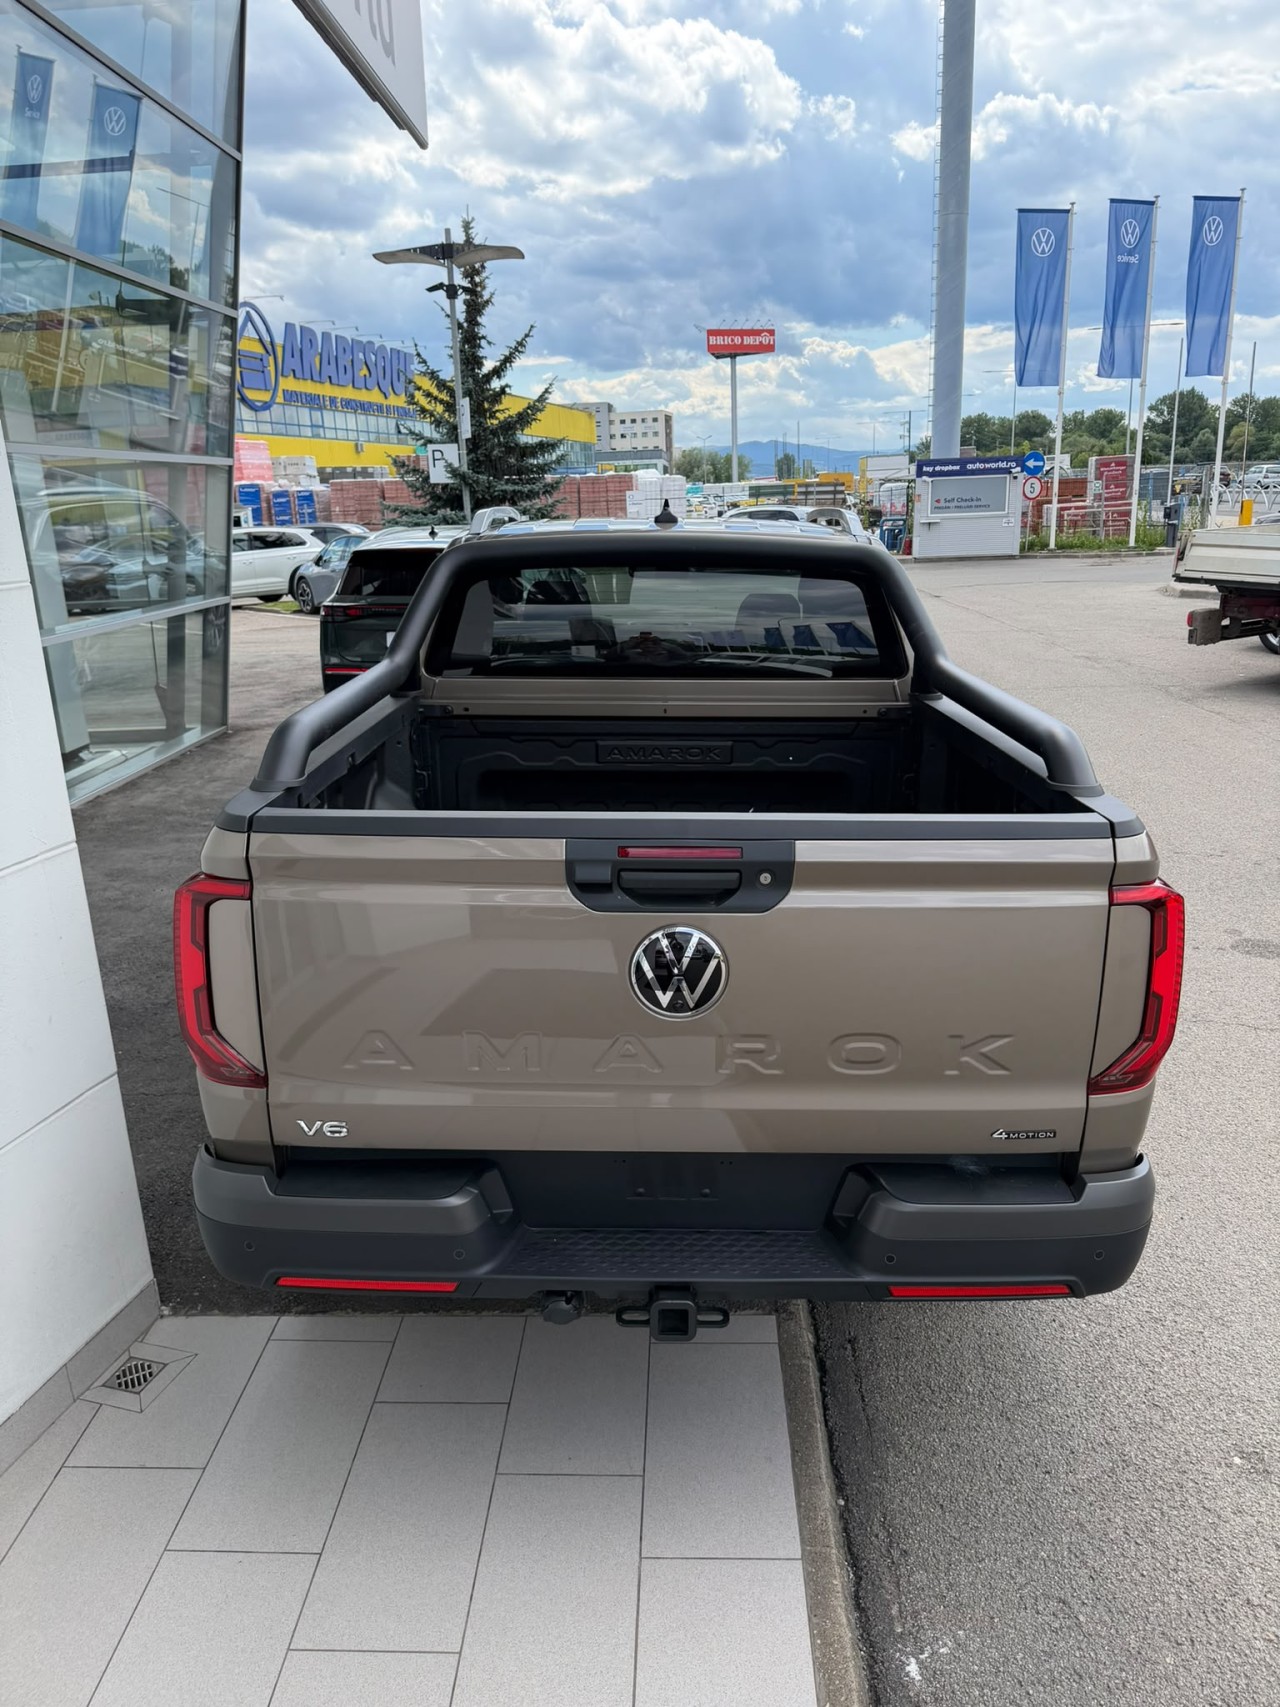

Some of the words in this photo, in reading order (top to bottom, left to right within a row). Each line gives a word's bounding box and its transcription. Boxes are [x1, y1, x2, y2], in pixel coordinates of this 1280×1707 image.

[709, 335, 742, 345] BRICO
[431, 449, 445, 468] P
[966, 460, 1017, 470] autoworld.ro
[922, 465, 934, 473] key
[934, 463, 961, 472] dropbox
[1029, 482, 1036, 494] 5
[607, 746, 722, 761] AMAROK
[341, 1028, 1015, 1077] AMAROK
[295, 1119, 349, 1138] V6
